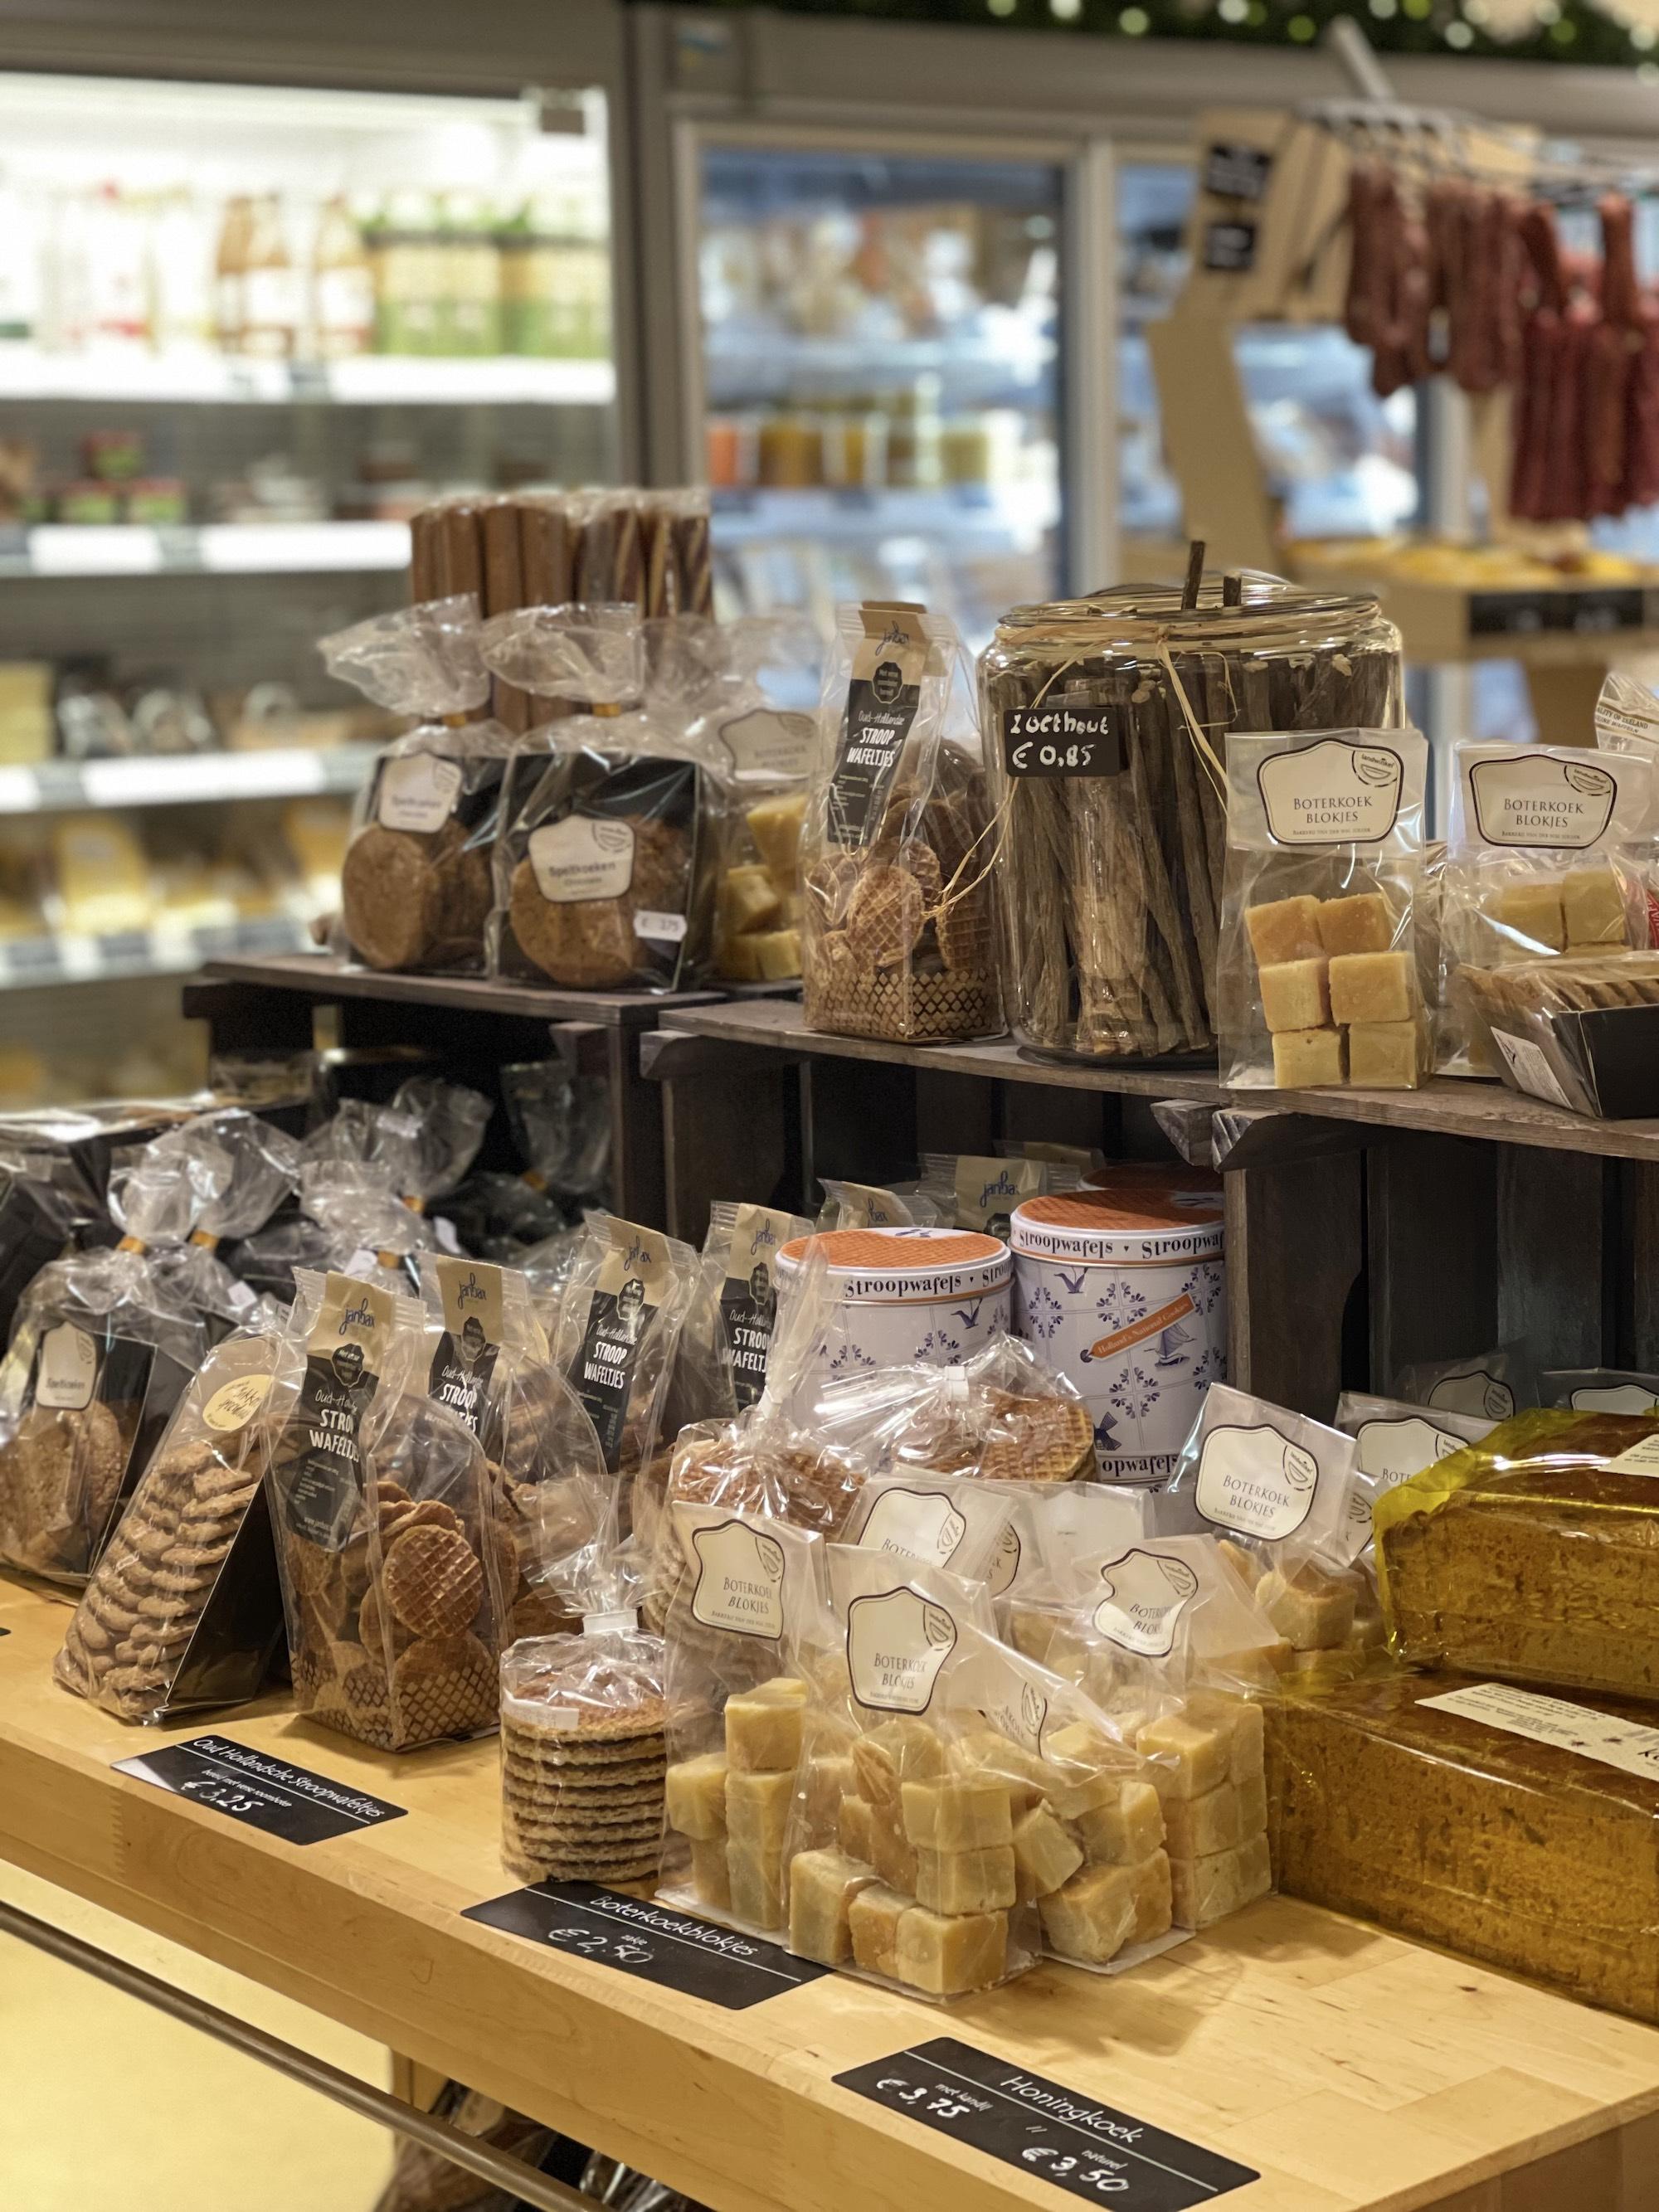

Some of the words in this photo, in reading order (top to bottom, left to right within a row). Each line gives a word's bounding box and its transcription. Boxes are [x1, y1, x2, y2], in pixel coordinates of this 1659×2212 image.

[860, 727, 896, 746] STROOP
[846, 747, 896, 768] WAFELTJES
[1012, 741, 1034, 769] €
[1039, 744, 1096, 767] 0,85
[1293, 796, 1374, 810] BOTERKOEK
[1504, 799, 1584, 814] BOTERKOEK
[1306, 811, 1359, 824] BLOKJES
[1515, 815, 1569, 829] BLOKJES
[1019, 1230, 1113, 1258] Stroopwafels
[1141, 1231, 1224, 1260] Stroopwaf
[458, 1272, 487, 1310] janbax
[844, 1275, 961, 1298] Stroopwafels
[338, 1298, 376, 1335] janbax
[1098, 1335, 1131, 1354] Holland's
[1132, 1317, 1164, 1336] National
[593, 1341, 627, 1365] STROOP
[584, 1361, 625, 1389] WAFELTJES
[440, 1383, 478, 1409] STROOP
[1102, 1454, 1178, 1476] opwafels
[1223, 1475, 1291, 1508] BOTERKOEK
[1229, 1495, 1277, 1519] BLOKJES
[728, 1596, 770, 1614] BLOKJES
[193, 1739, 230, 1753] Oud
[199, 1788, 265, 1811] 3,25
[548, 1928, 590, 1943] €
[590, 1895, 758, 1958] Boterkoekblokjes
[935, 2083, 961, 2097] met
[898, 2087, 971, 2118] 3,75
[1000, 2075, 1144, 2143] Honingkoek
[1022, 2146, 1059, 2162] €
[1048, 2156, 1130, 2192] 3,50
